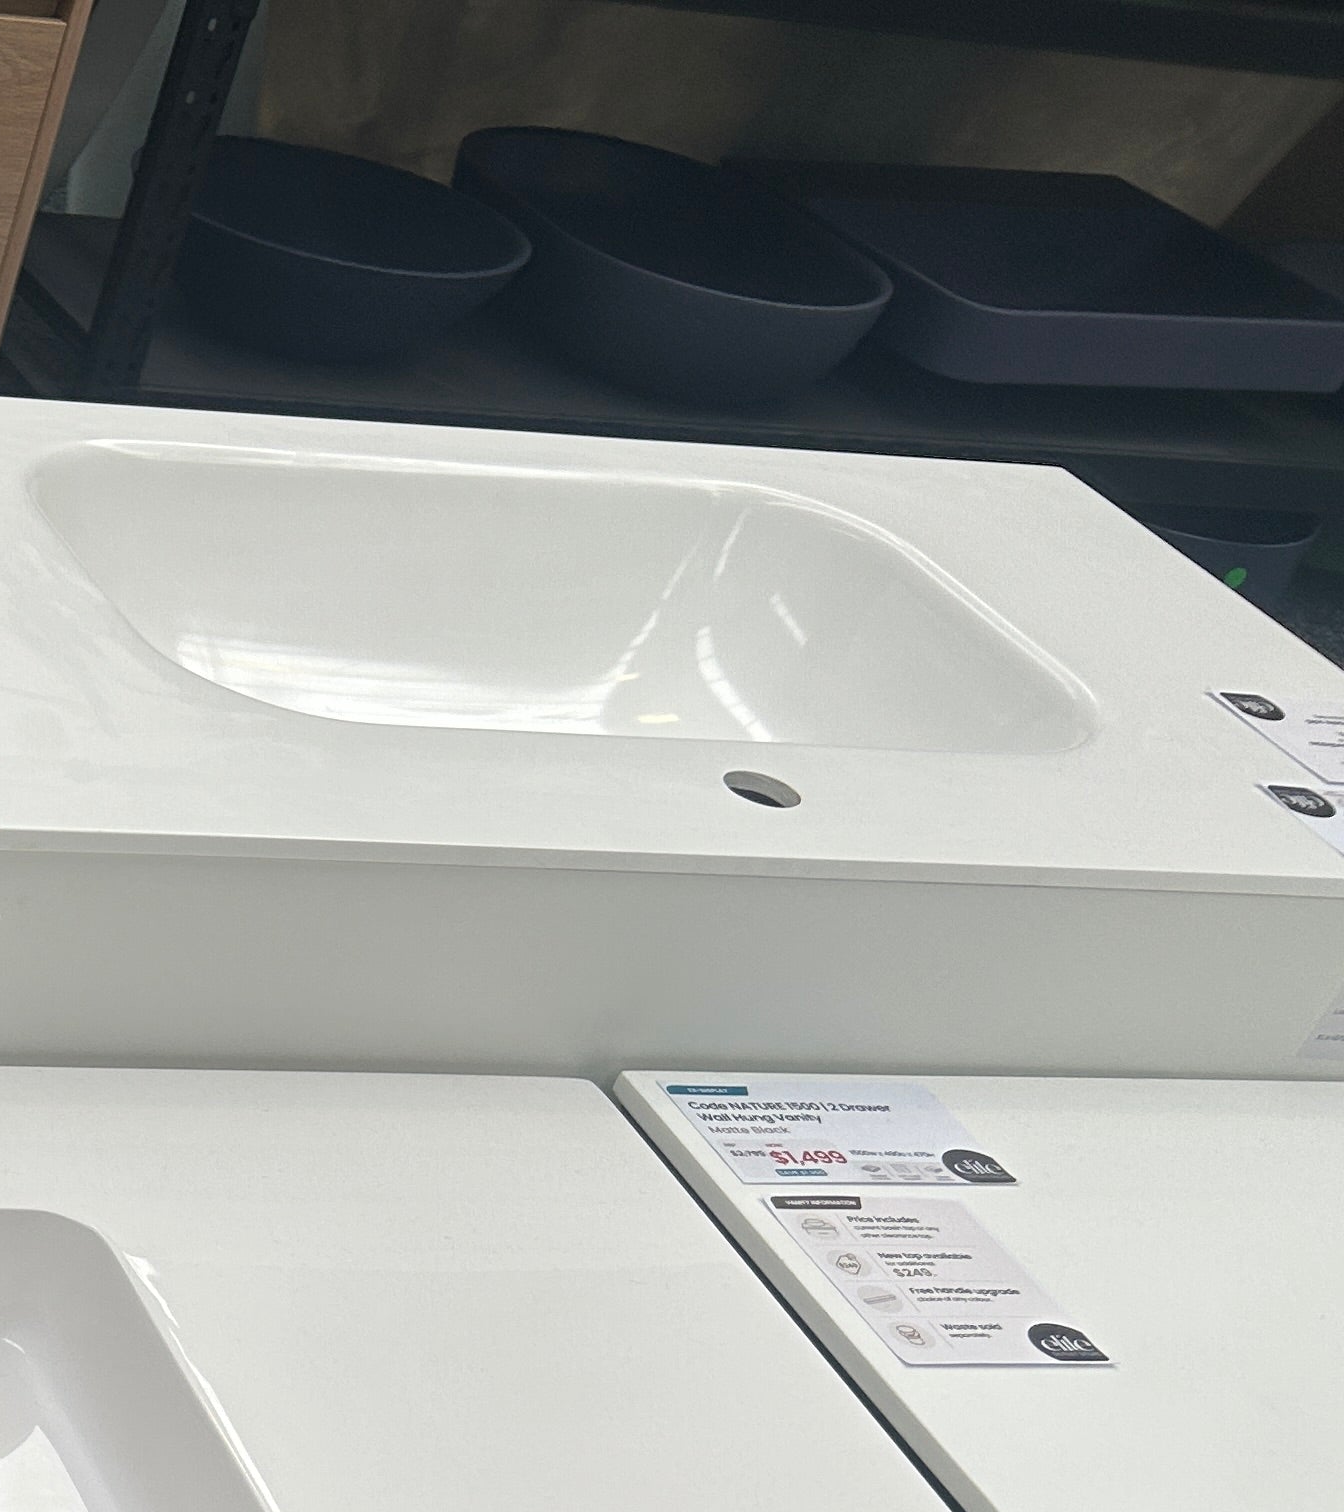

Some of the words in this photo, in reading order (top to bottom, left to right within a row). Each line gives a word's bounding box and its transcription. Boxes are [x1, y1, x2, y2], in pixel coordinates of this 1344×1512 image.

[687, 1101, 728, 1110] Code
[729, 1102, 786, 1111] NATURE
[786, 1102, 821, 1111] 1500
[831, 1103, 839, 1111] 2
[841, 1103, 891, 1112] Drawer
[697, 1112, 732, 1121] Wall
[734, 1113, 776, 1124] Hung
[776, 1113, 822, 1124] Vanity
[708, 1126, 750, 1134] Matte
[751, 1126, 791, 1134] Black
[769, 1150, 848, 1166] $1,499
[873, 1216, 920, 1224] includes
